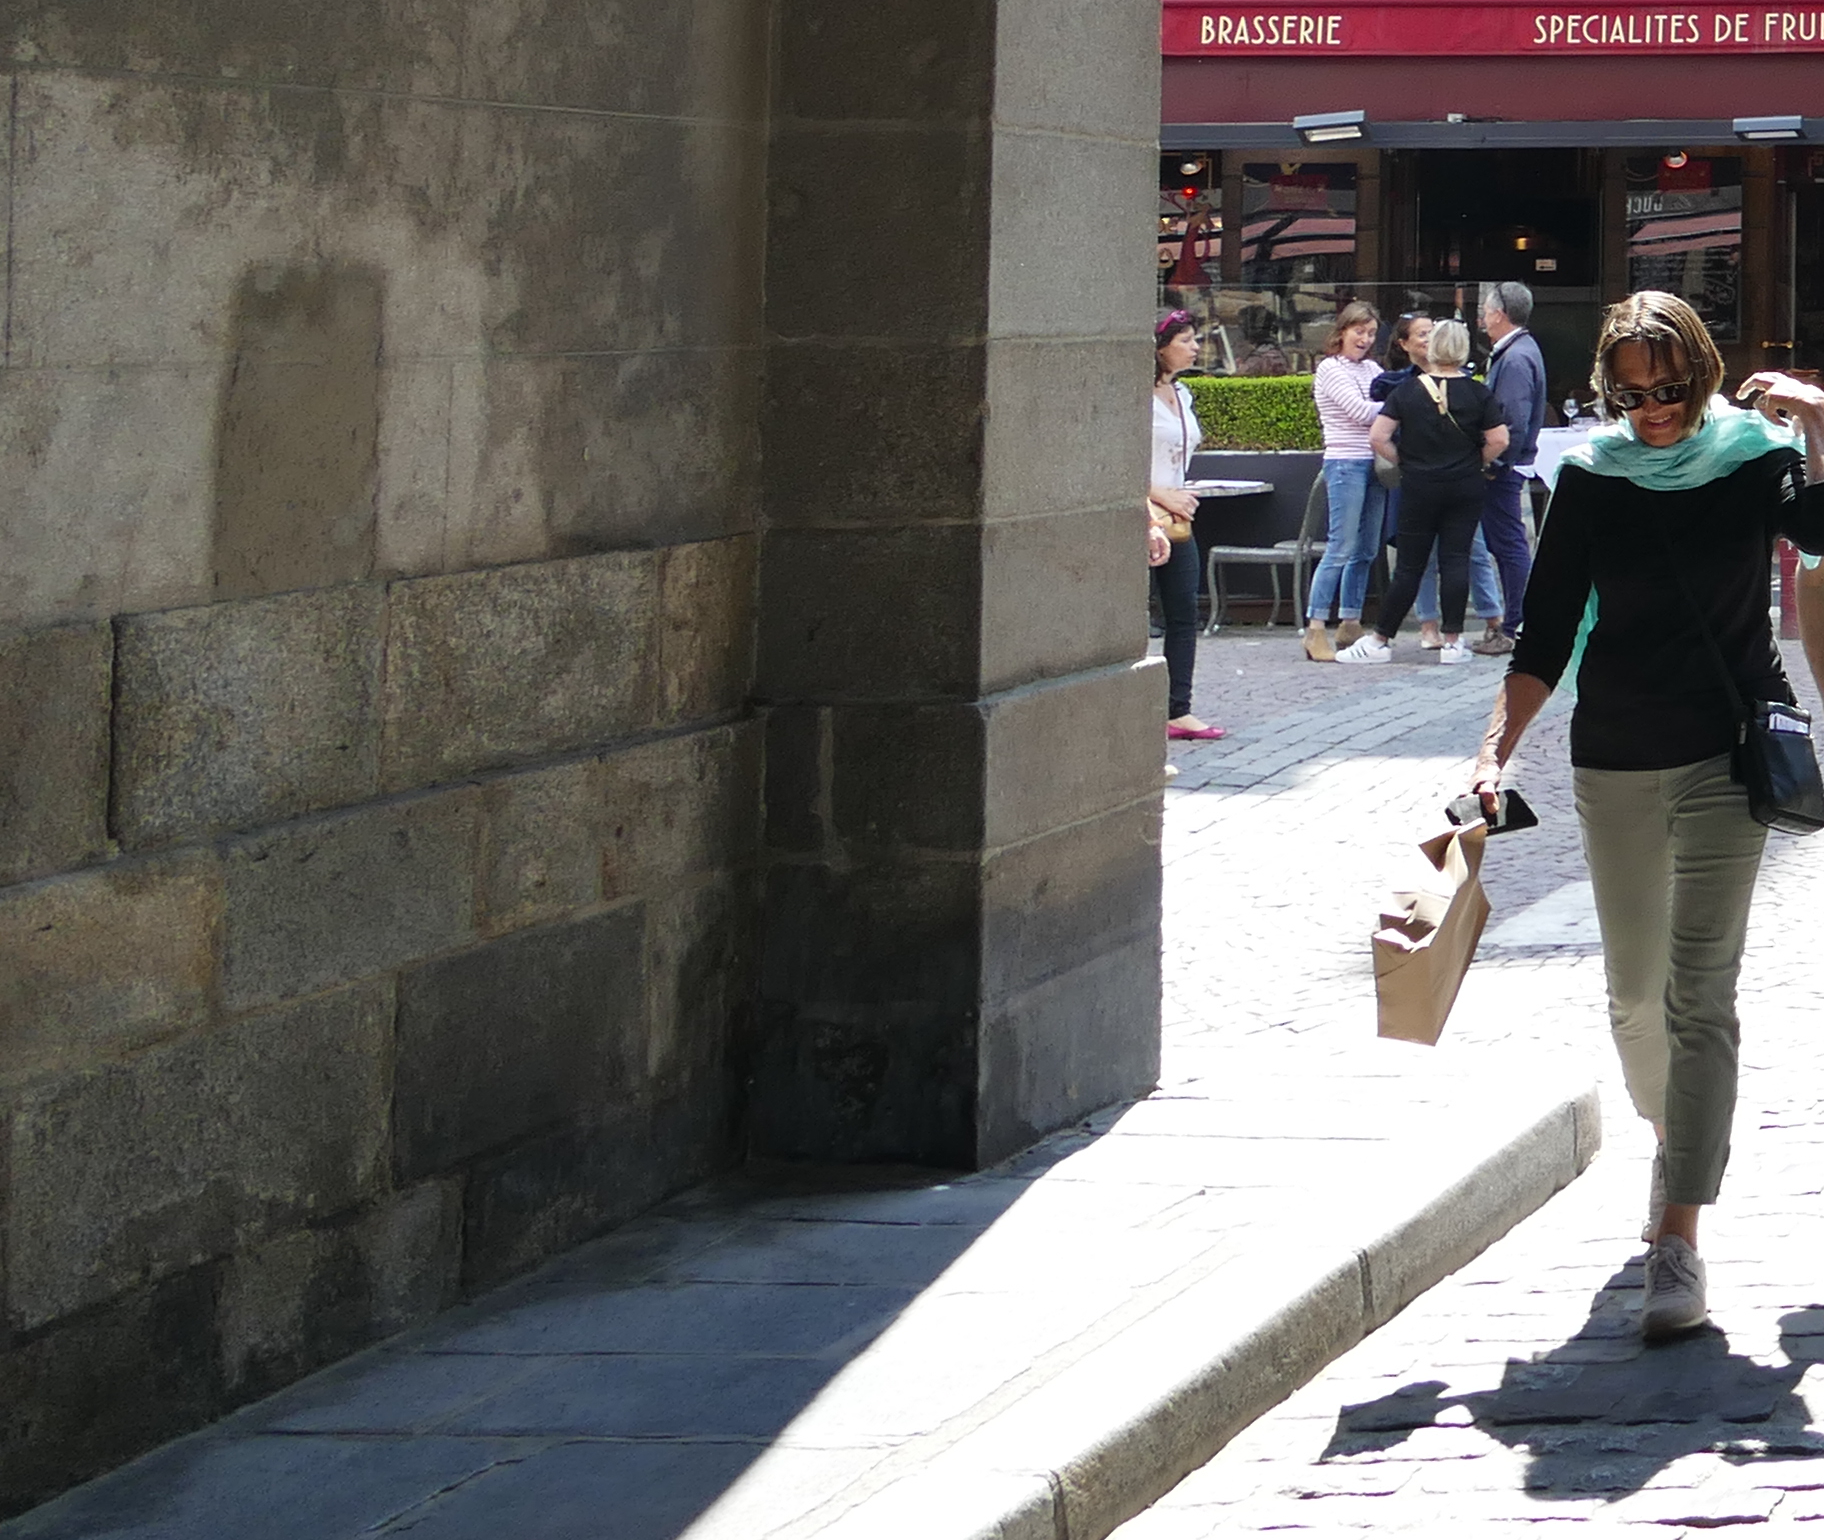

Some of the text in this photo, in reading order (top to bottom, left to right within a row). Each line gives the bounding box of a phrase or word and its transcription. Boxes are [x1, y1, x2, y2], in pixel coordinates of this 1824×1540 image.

[1200, 15, 1343, 45] BRASSERIE
[1533, 14, 1701, 44] SPECIALITES
[1714, 13, 1750, 43] DE
